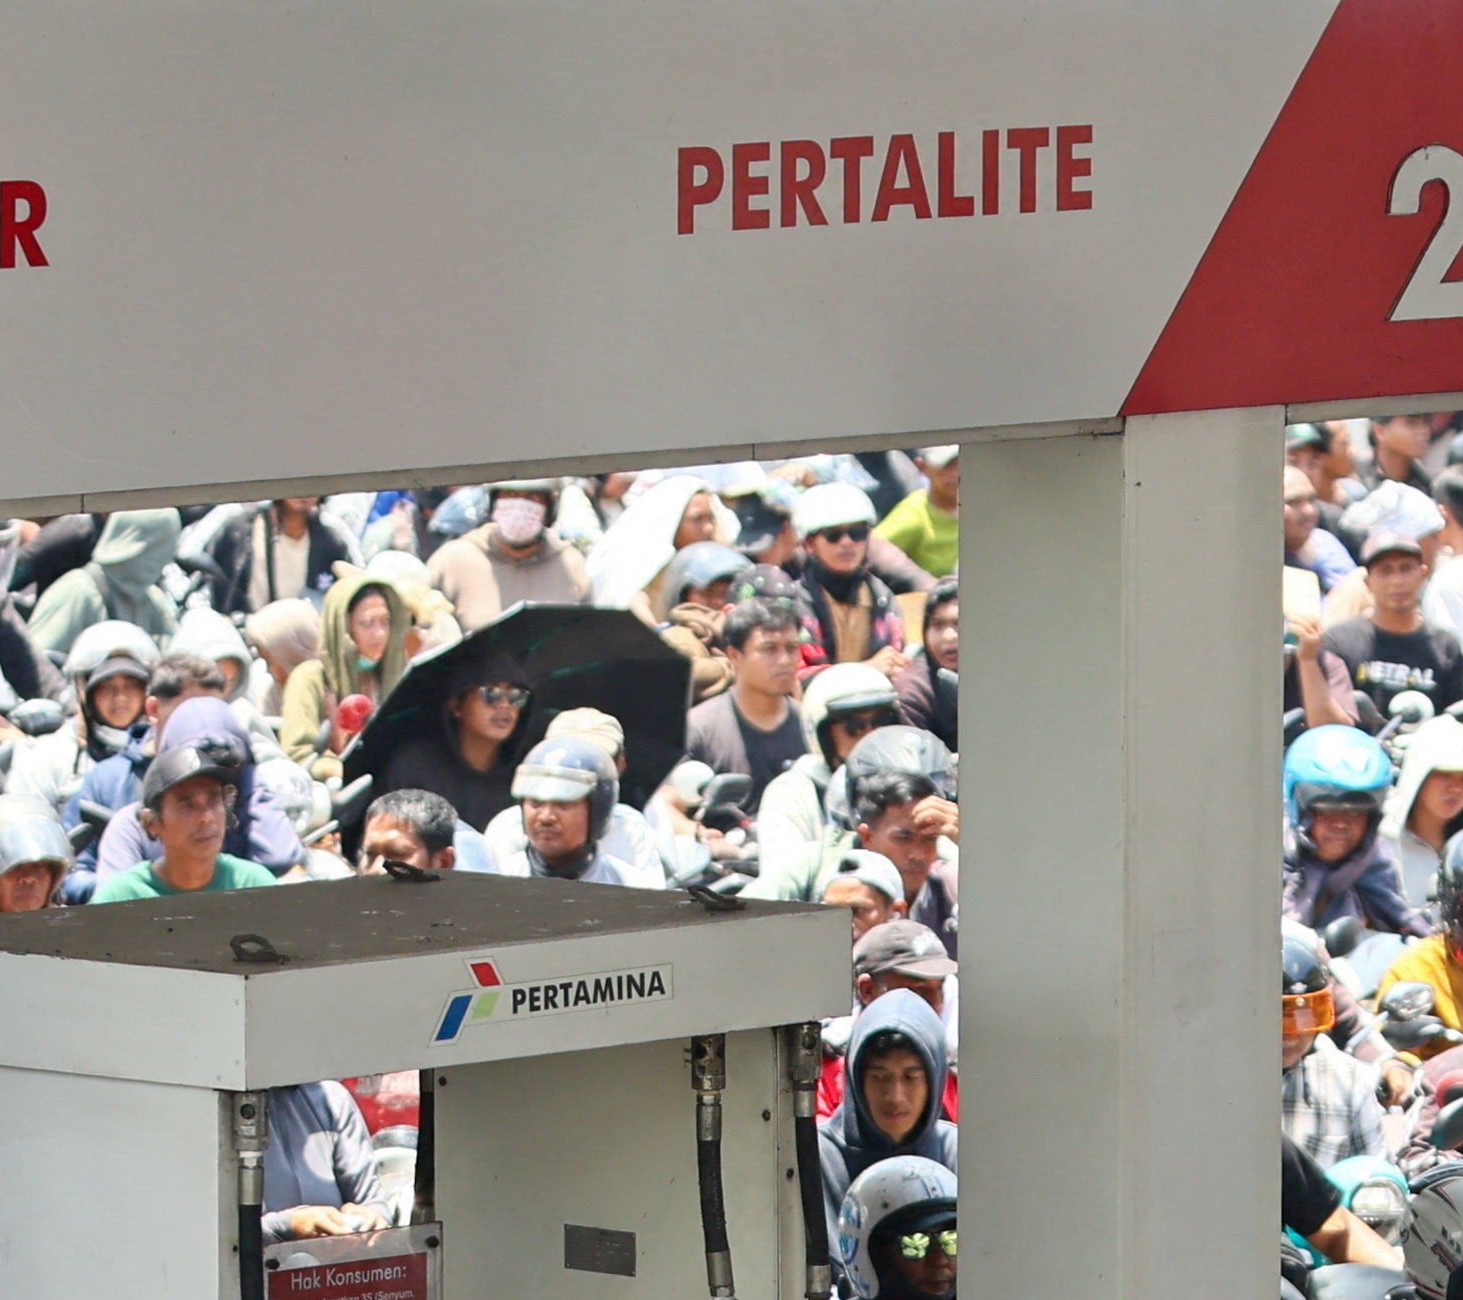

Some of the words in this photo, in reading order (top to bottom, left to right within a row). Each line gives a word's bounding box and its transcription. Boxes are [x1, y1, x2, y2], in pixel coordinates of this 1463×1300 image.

[677, 124, 1093, 235] PERTALITE
[513, 970, 666, 1014] PERTAMINA
[291, 1270, 321, 1290] Hak
[326, 1265, 408, 1287] Konsumen:
